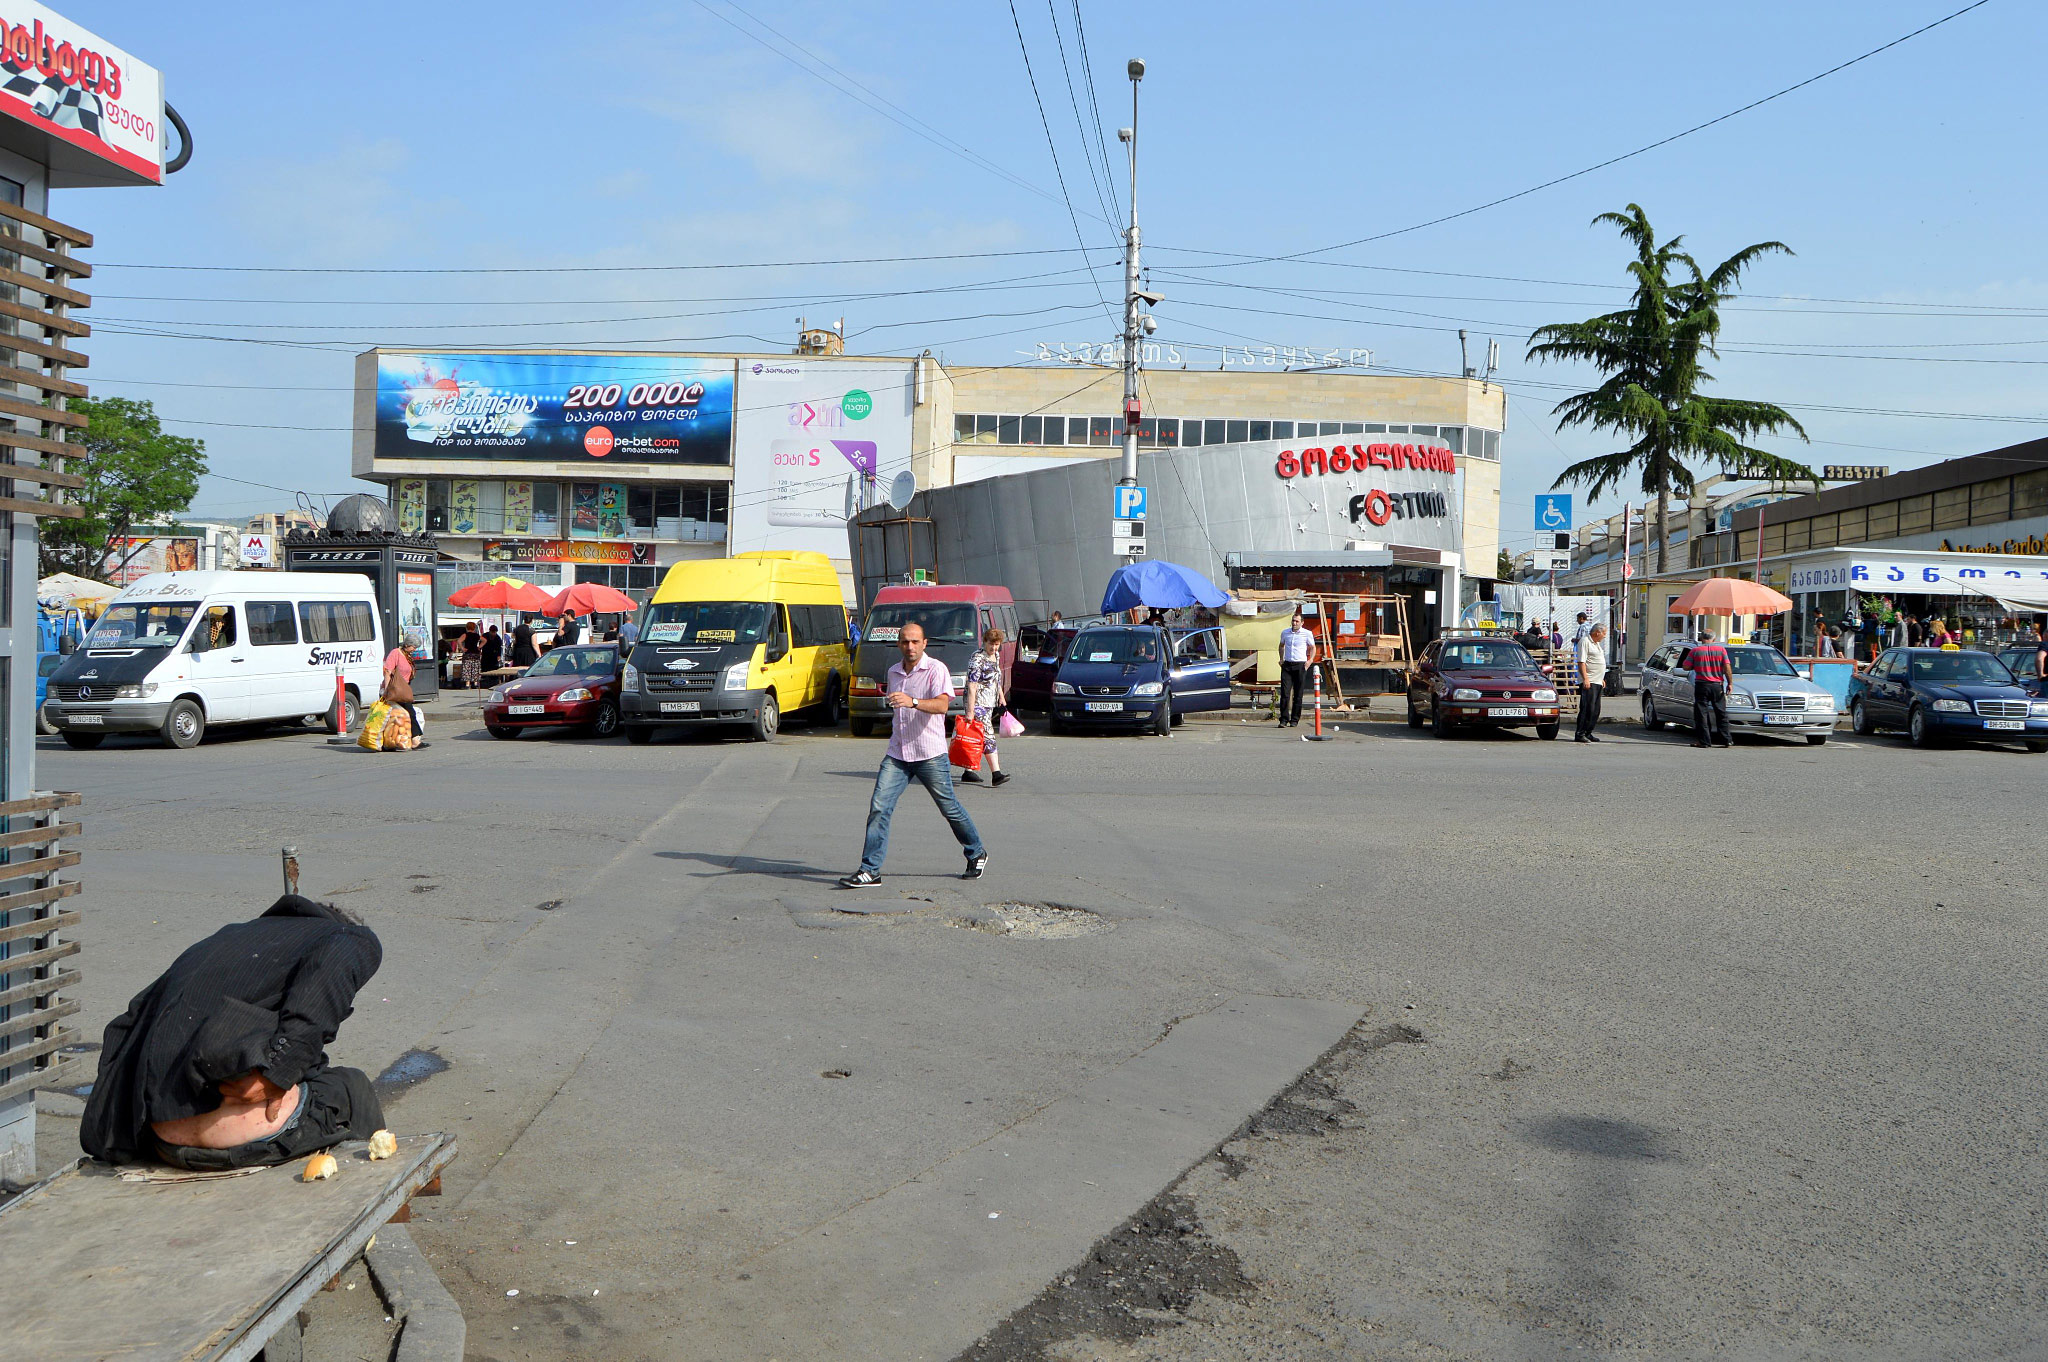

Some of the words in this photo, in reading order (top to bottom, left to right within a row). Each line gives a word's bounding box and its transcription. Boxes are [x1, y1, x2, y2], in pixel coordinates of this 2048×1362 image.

[106, 101, 154, 142] ფუდი
[1037, 342, 1182, 364] ბავშთა
[564, 384, 622, 407] 200
[565, 411, 636, 422] საპრიზო
[642, 409, 698, 421] ფონდი
[845, 405, 869, 413] იაფი
[774, 453, 804, 466] მეტი
[808, 448, 821, 466] S
[1120, 488, 1143, 517] P
[568, 545, 629, 563] სამყარო
[2001, 535, 2042, 556] Carlo
[309, 552, 366, 560] PRESS
[402, 554, 427, 562] PRESS
[1791, 567, 1846, 588] ჩანთები
[308, 647, 363, 666] SPRINTER
